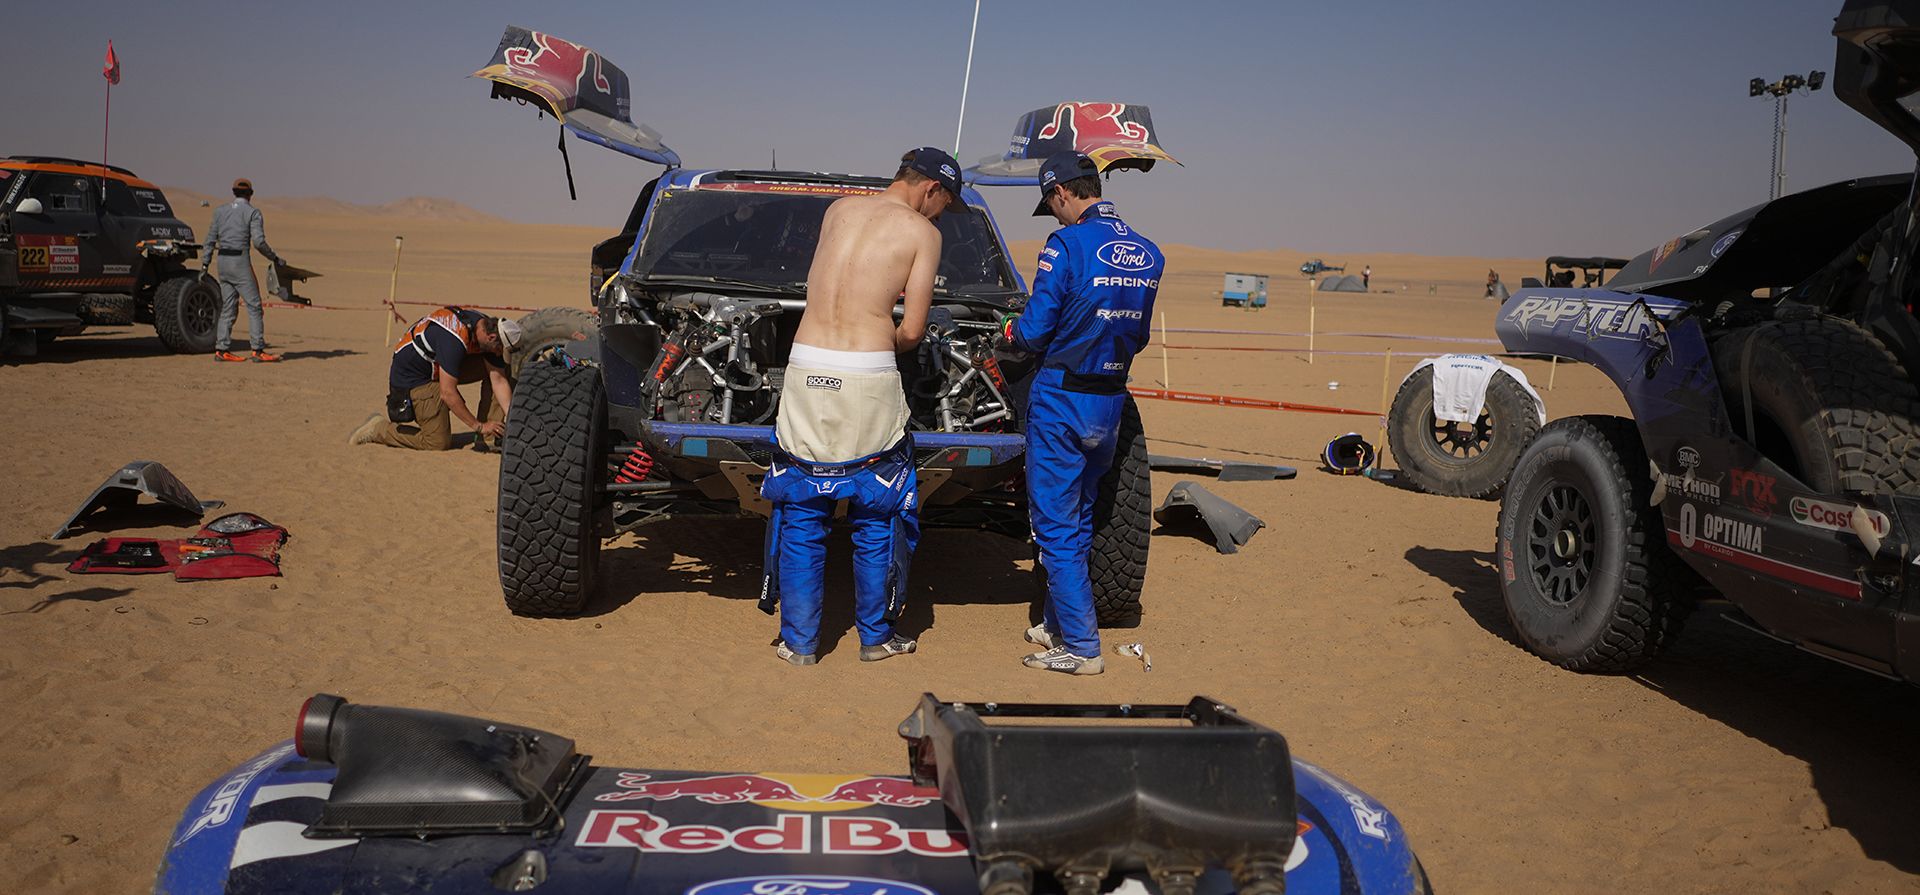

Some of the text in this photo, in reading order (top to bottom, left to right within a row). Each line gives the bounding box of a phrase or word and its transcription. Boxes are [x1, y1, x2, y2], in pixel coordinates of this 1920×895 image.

[22, 248, 45, 266] 222
[53, 255, 76, 264] MOTUL
[1112, 244, 1146, 266] Ford
[1093, 276, 1159, 289] RACING
[1096, 309, 1143, 320] RAPTO
[807, 376, 841, 386] sparco
[1679, 451, 1698, 464] BMC
[1731, 468, 1777, 511] FOX
[1810, 504, 1882, 534] Castl
[1703, 513, 1762, 553] OPTIMA
[575, 810, 970, 857] Red Bu
